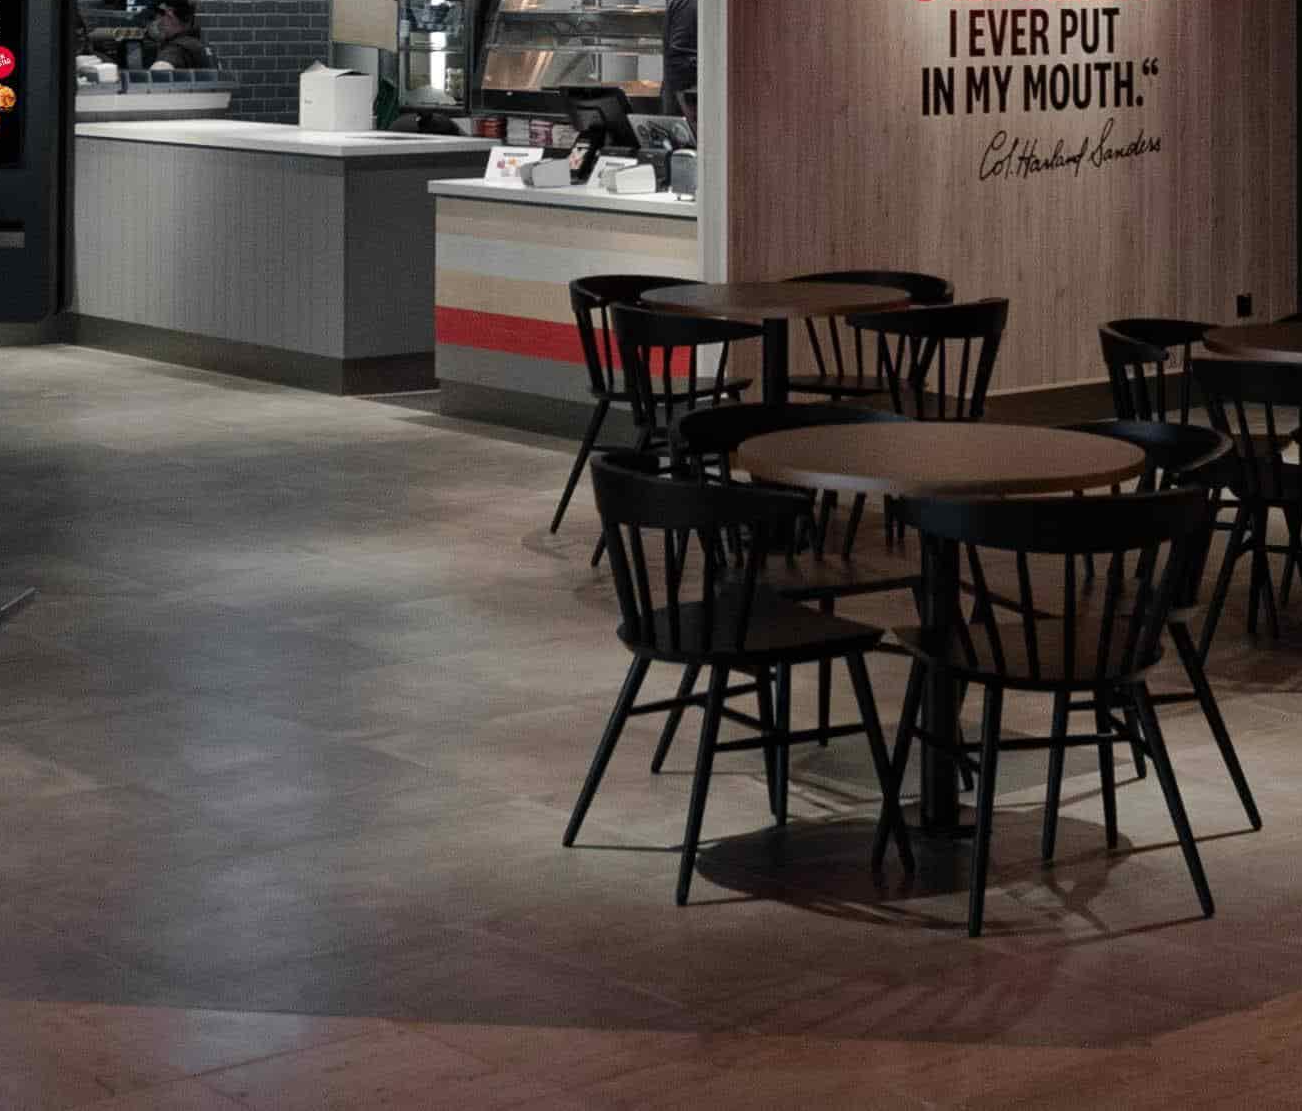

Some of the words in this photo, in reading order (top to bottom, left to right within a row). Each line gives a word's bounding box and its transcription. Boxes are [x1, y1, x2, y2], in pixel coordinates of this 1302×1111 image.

[949, 9, 957, 57] I
[969, 8, 1049, 57] EVER
[1060, 7, 1120, 55] PUT
[922, 67, 955, 116] IN
[966, 65, 1013, 114] MY
[1089, 117, 1162, 168] Sanders
